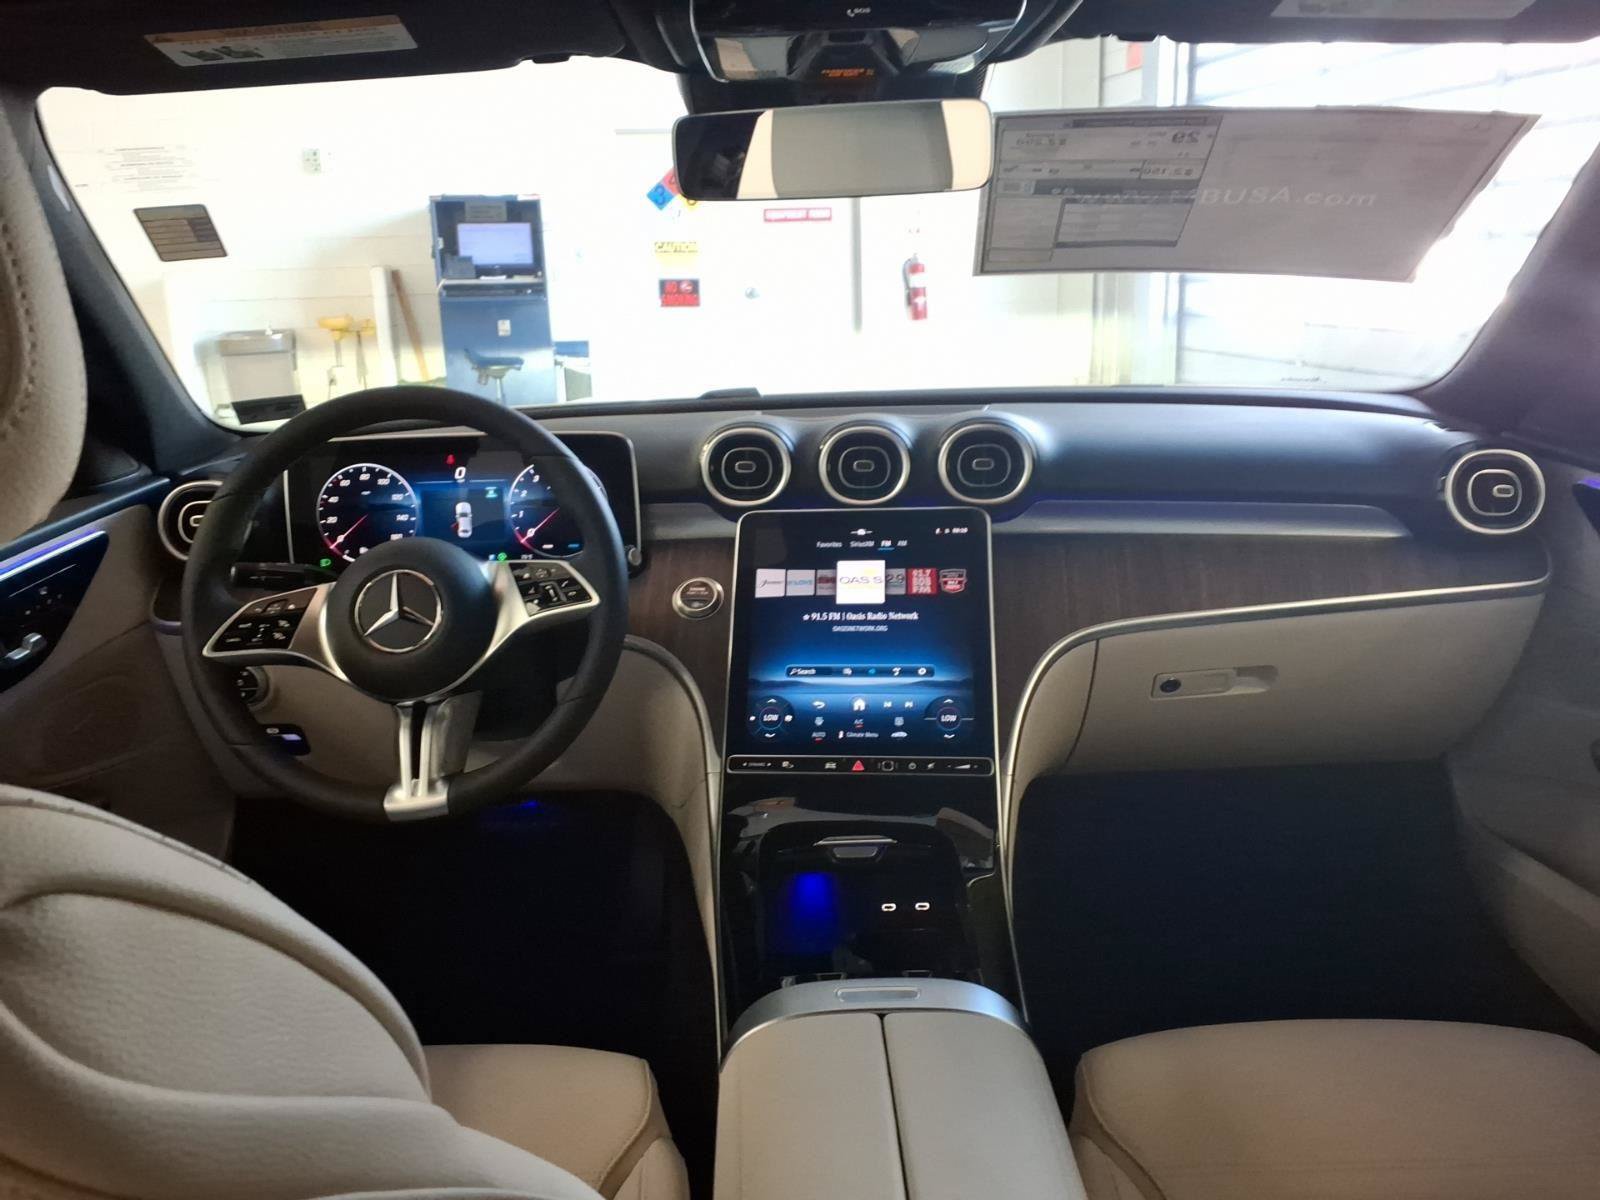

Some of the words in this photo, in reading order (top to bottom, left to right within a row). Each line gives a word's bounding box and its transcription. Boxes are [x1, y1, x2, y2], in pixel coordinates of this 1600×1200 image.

[880, 539, 892, 547] FM
[839, 575, 884, 585] OASS
[810, 612, 828, 621] 91.5
[828, 612, 841, 621] FM
[846, 612, 866, 621] Oasis
[867, 612, 888, 621] Radio
[888, 611, 919, 620] Network
[763, 713, 779, 722] LOW
[940, 713, 957, 722] LOW
